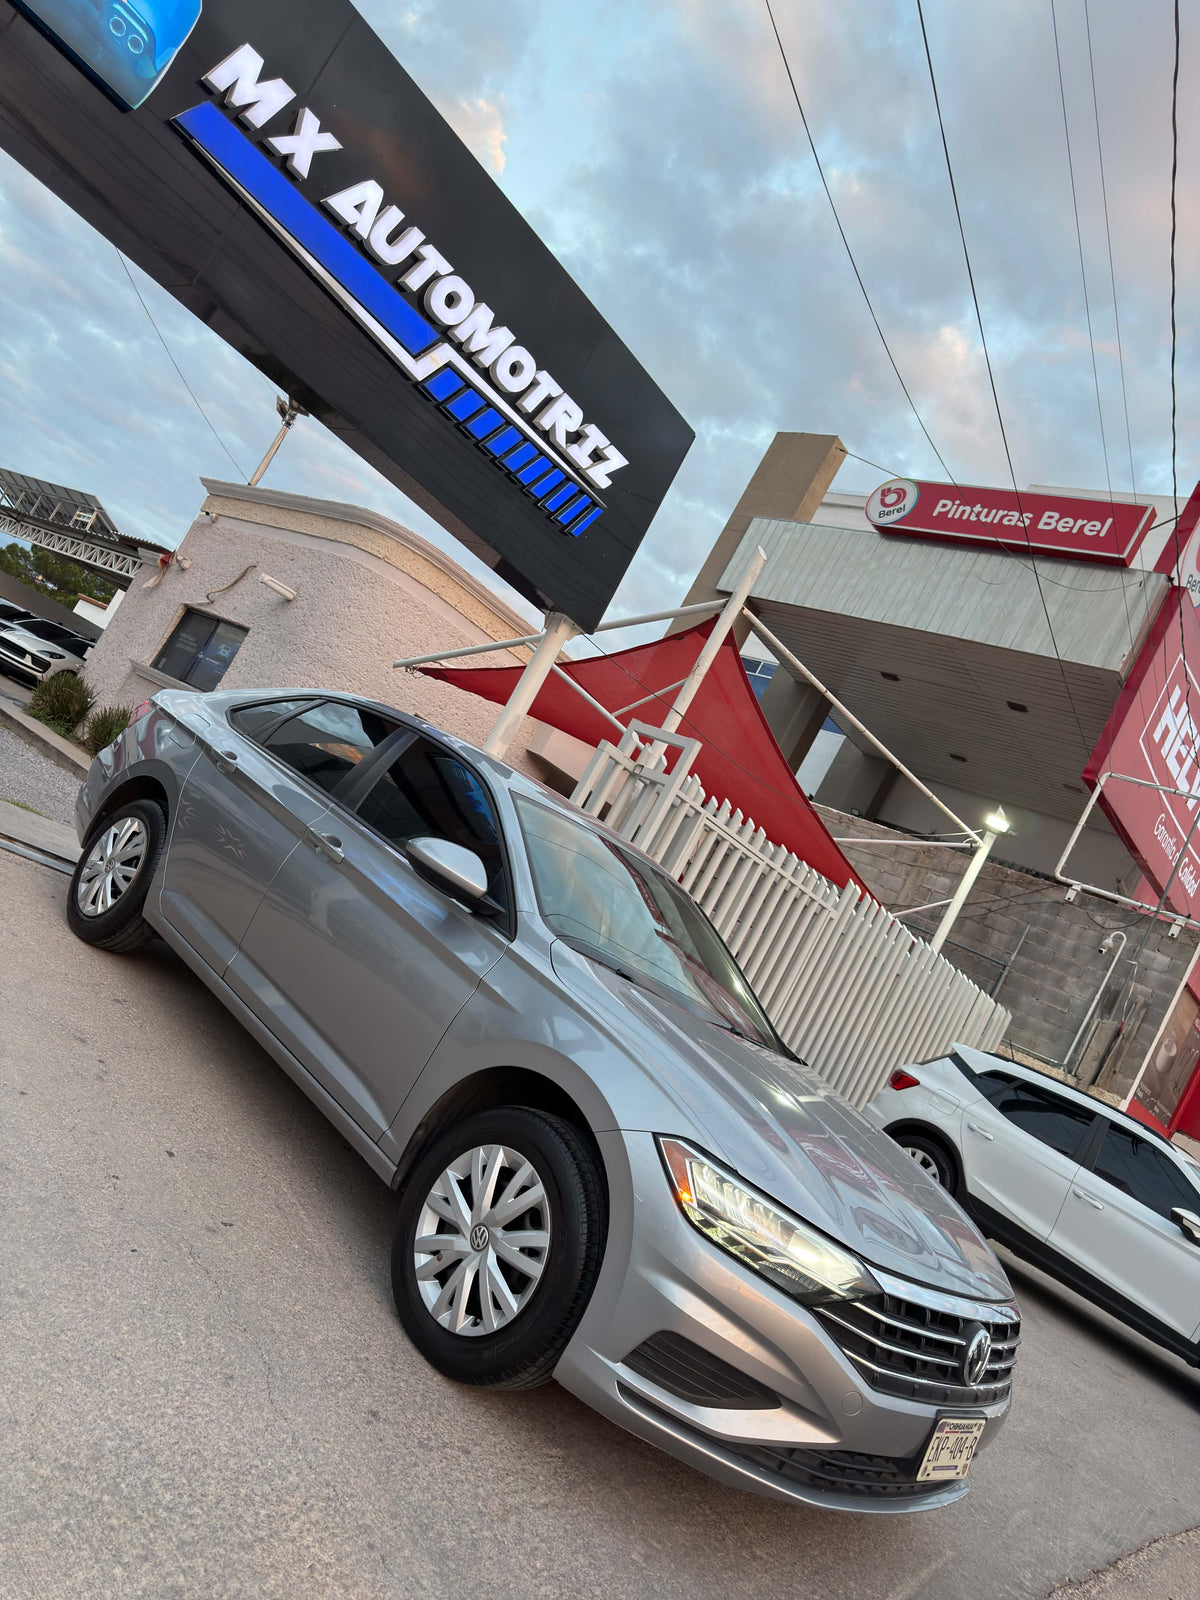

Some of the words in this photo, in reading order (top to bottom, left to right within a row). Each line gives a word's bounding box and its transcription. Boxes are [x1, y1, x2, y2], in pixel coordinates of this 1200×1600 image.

[201, 42, 342, 180] MX
[320, 178, 630, 490] AUTOMOTRIZ
[878, 503, 906, 519] Berel
[932, 499, 1033, 527] Pinturas
[1037, 511, 1113, 538] Berel
[926, 1435, 978, 1463] EKP-404-B
